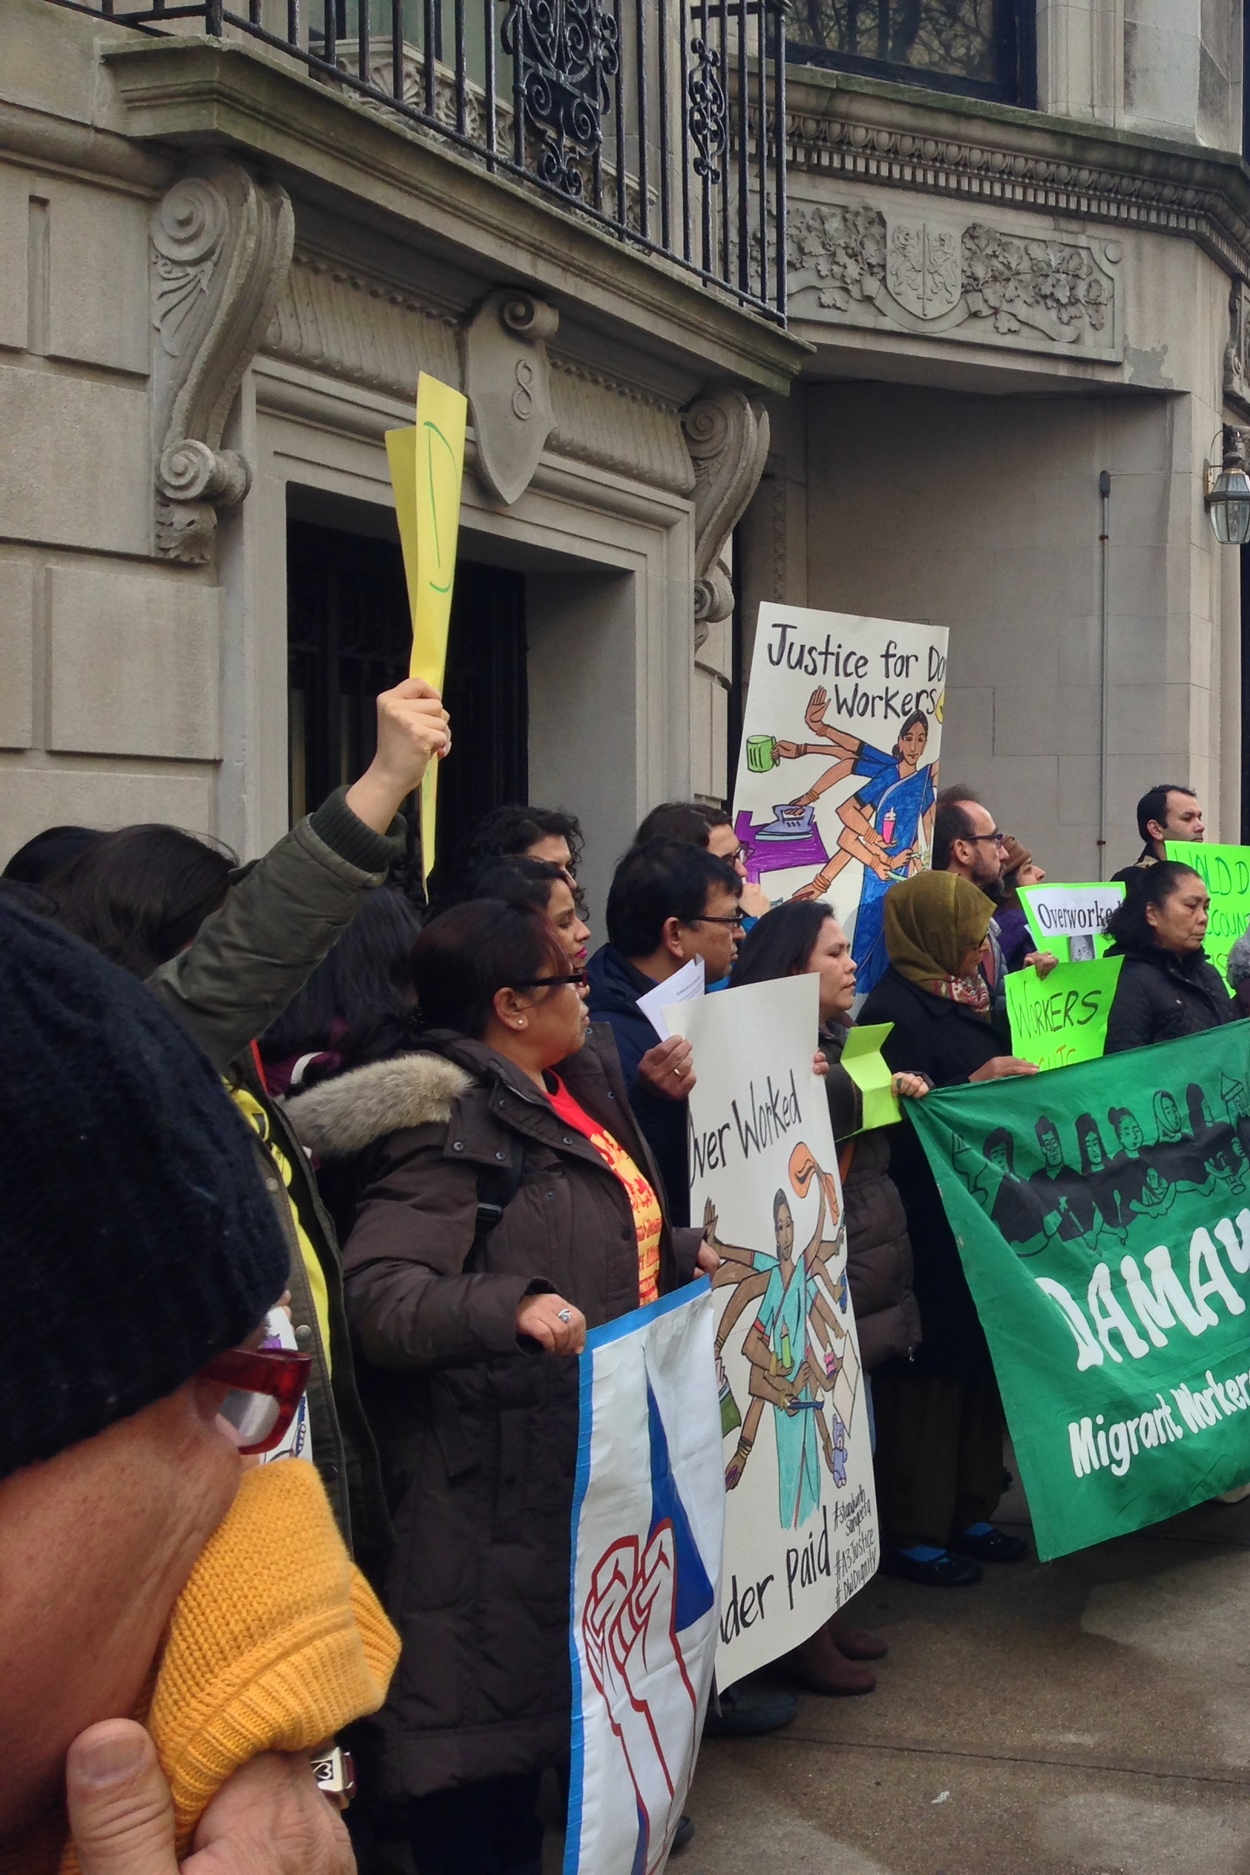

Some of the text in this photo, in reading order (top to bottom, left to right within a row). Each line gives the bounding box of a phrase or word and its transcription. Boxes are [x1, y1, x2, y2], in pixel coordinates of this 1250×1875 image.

[511, 359, 534, 421] 8
[767, 623, 869, 677] Justice
[880, 639, 919, 679] for
[834, 682, 937, 719] Workers
[1037, 900, 1123, 929] Overworke
[1008, 980, 1103, 1039] WORKERS
[731, 1068, 802, 1160] Worked
[1068, 1393, 1183, 1478] Migrant
